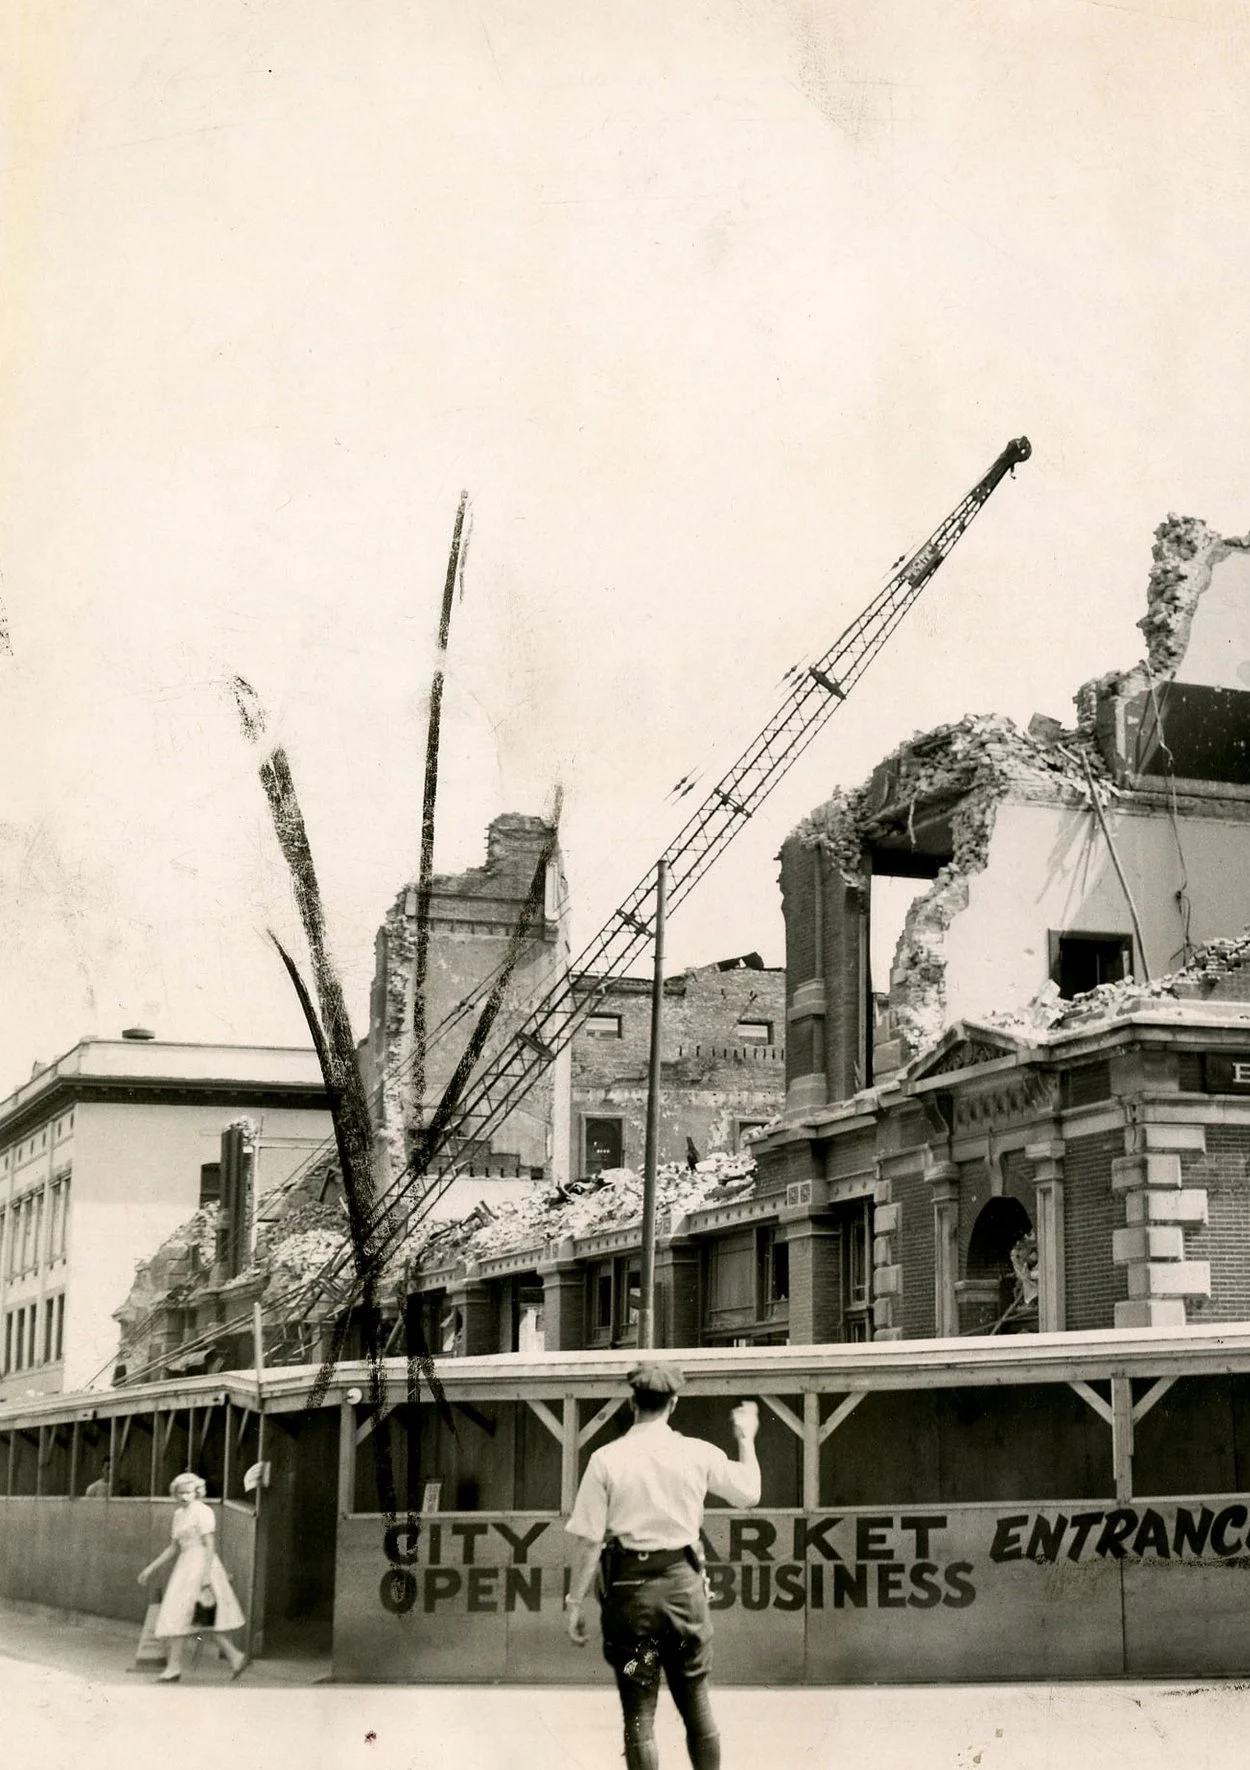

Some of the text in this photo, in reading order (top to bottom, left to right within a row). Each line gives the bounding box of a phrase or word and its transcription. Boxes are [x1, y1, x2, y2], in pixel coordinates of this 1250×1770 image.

[383, 1521, 551, 1566] CITY
[699, 1515, 948, 1562] RKET
[379, 1566, 542, 1615] OPEN
[704, 1561, 976, 1612] BUSINESS
